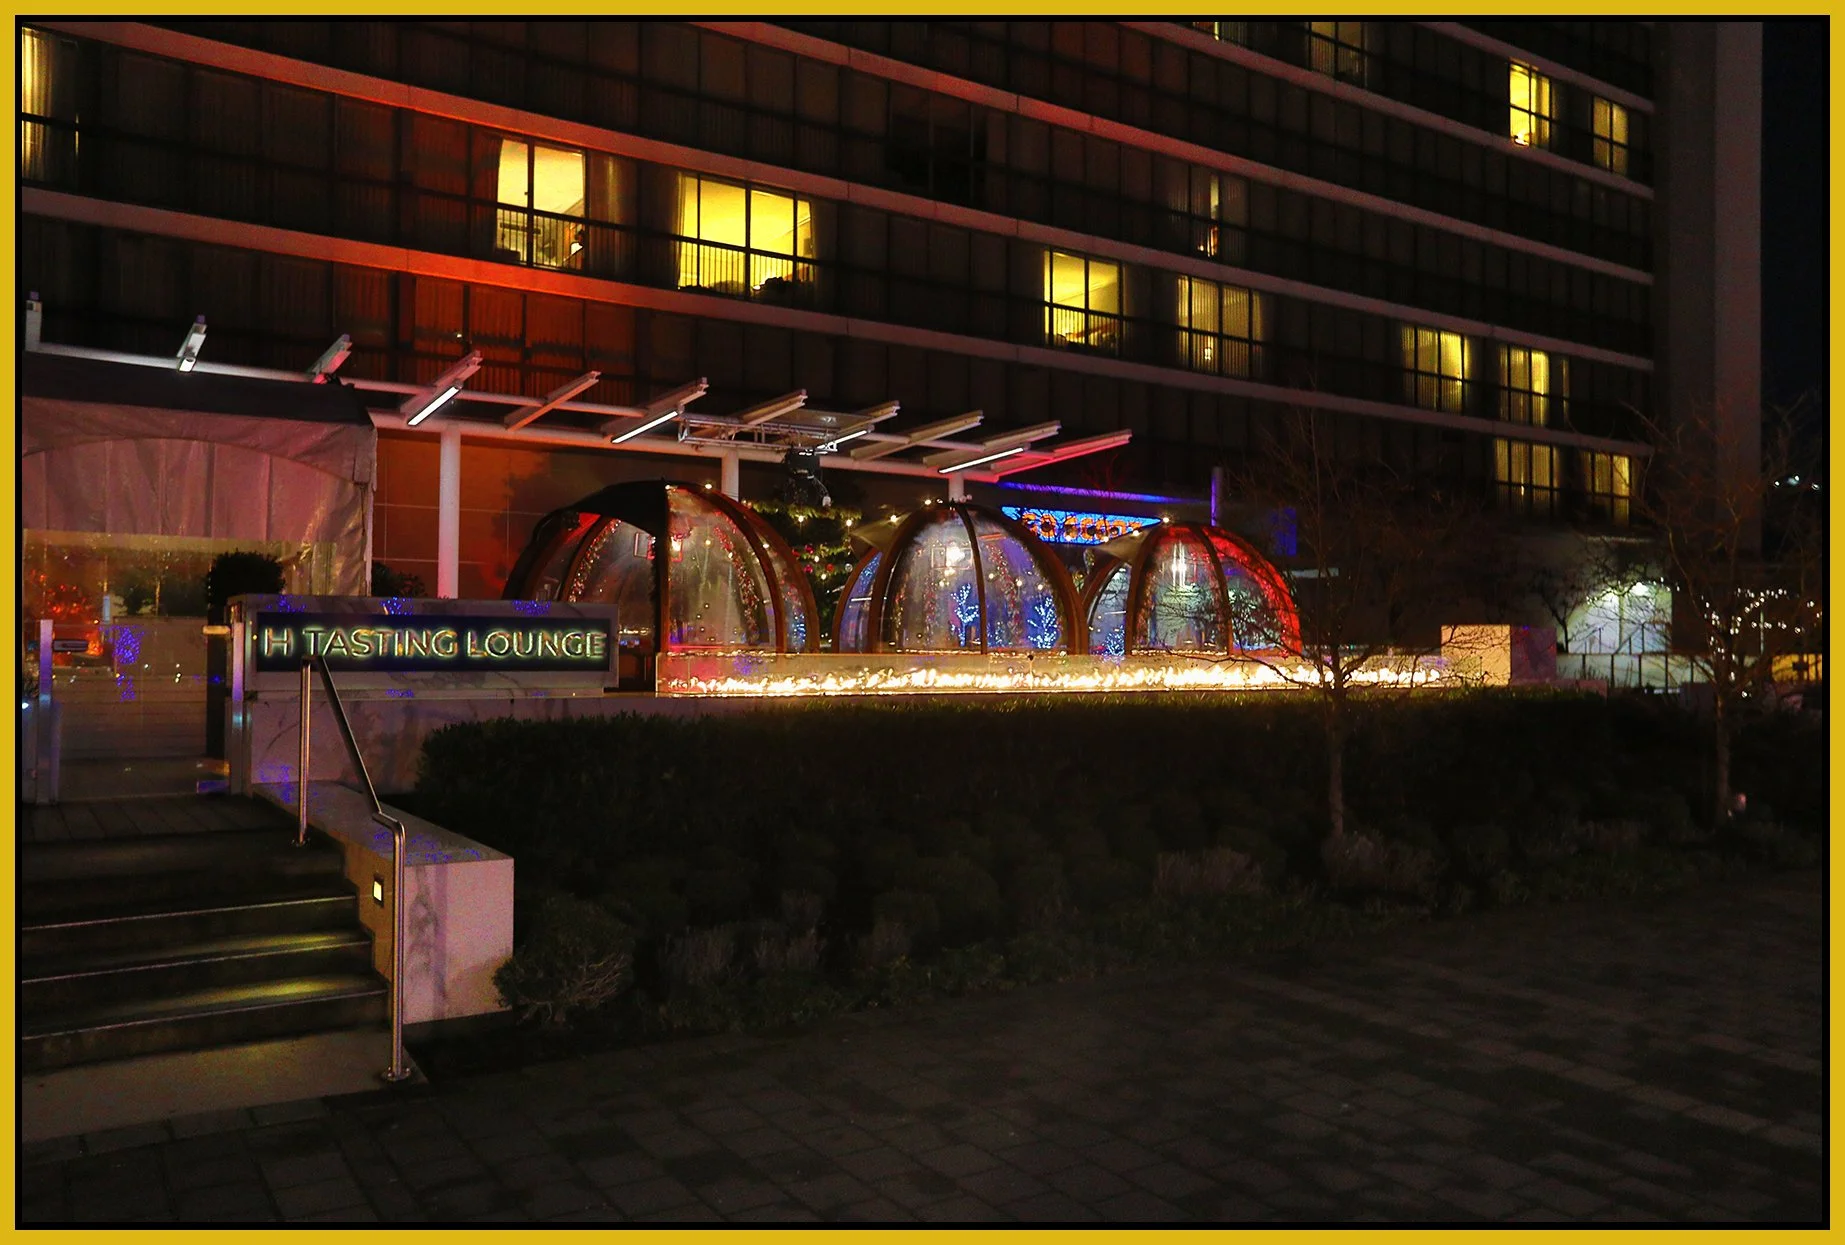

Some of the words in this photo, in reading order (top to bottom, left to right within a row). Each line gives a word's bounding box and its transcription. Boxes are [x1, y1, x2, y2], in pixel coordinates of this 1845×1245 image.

[264, 627, 291, 656] H
[302, 627, 458, 658] TASTING
[467, 631, 607, 658] LOUNGE
